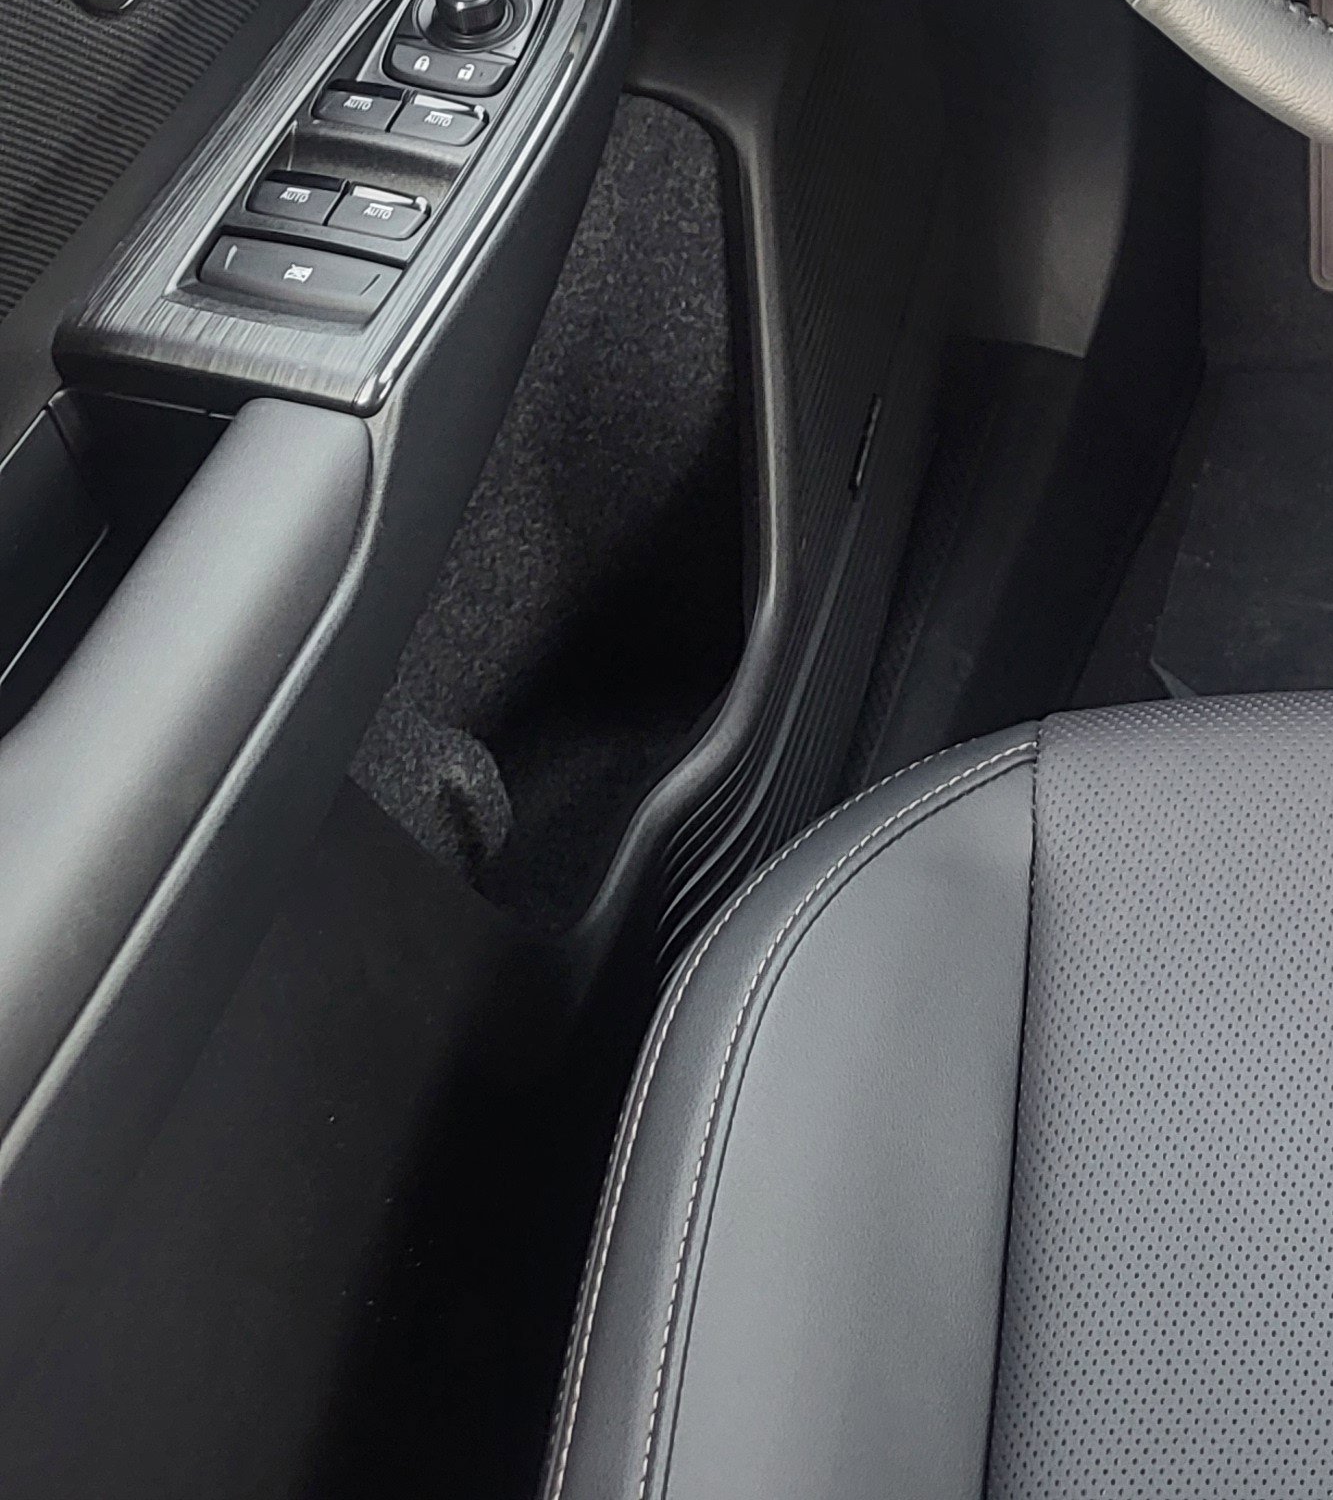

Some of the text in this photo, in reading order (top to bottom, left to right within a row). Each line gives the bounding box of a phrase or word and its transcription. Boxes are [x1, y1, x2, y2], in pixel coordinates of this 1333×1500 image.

[343, 98, 371, 111] AUTO
[425, 113, 452, 127] AUTO
[280, 189, 309, 203] AUTO
[364, 207, 391, 220] AUTO
